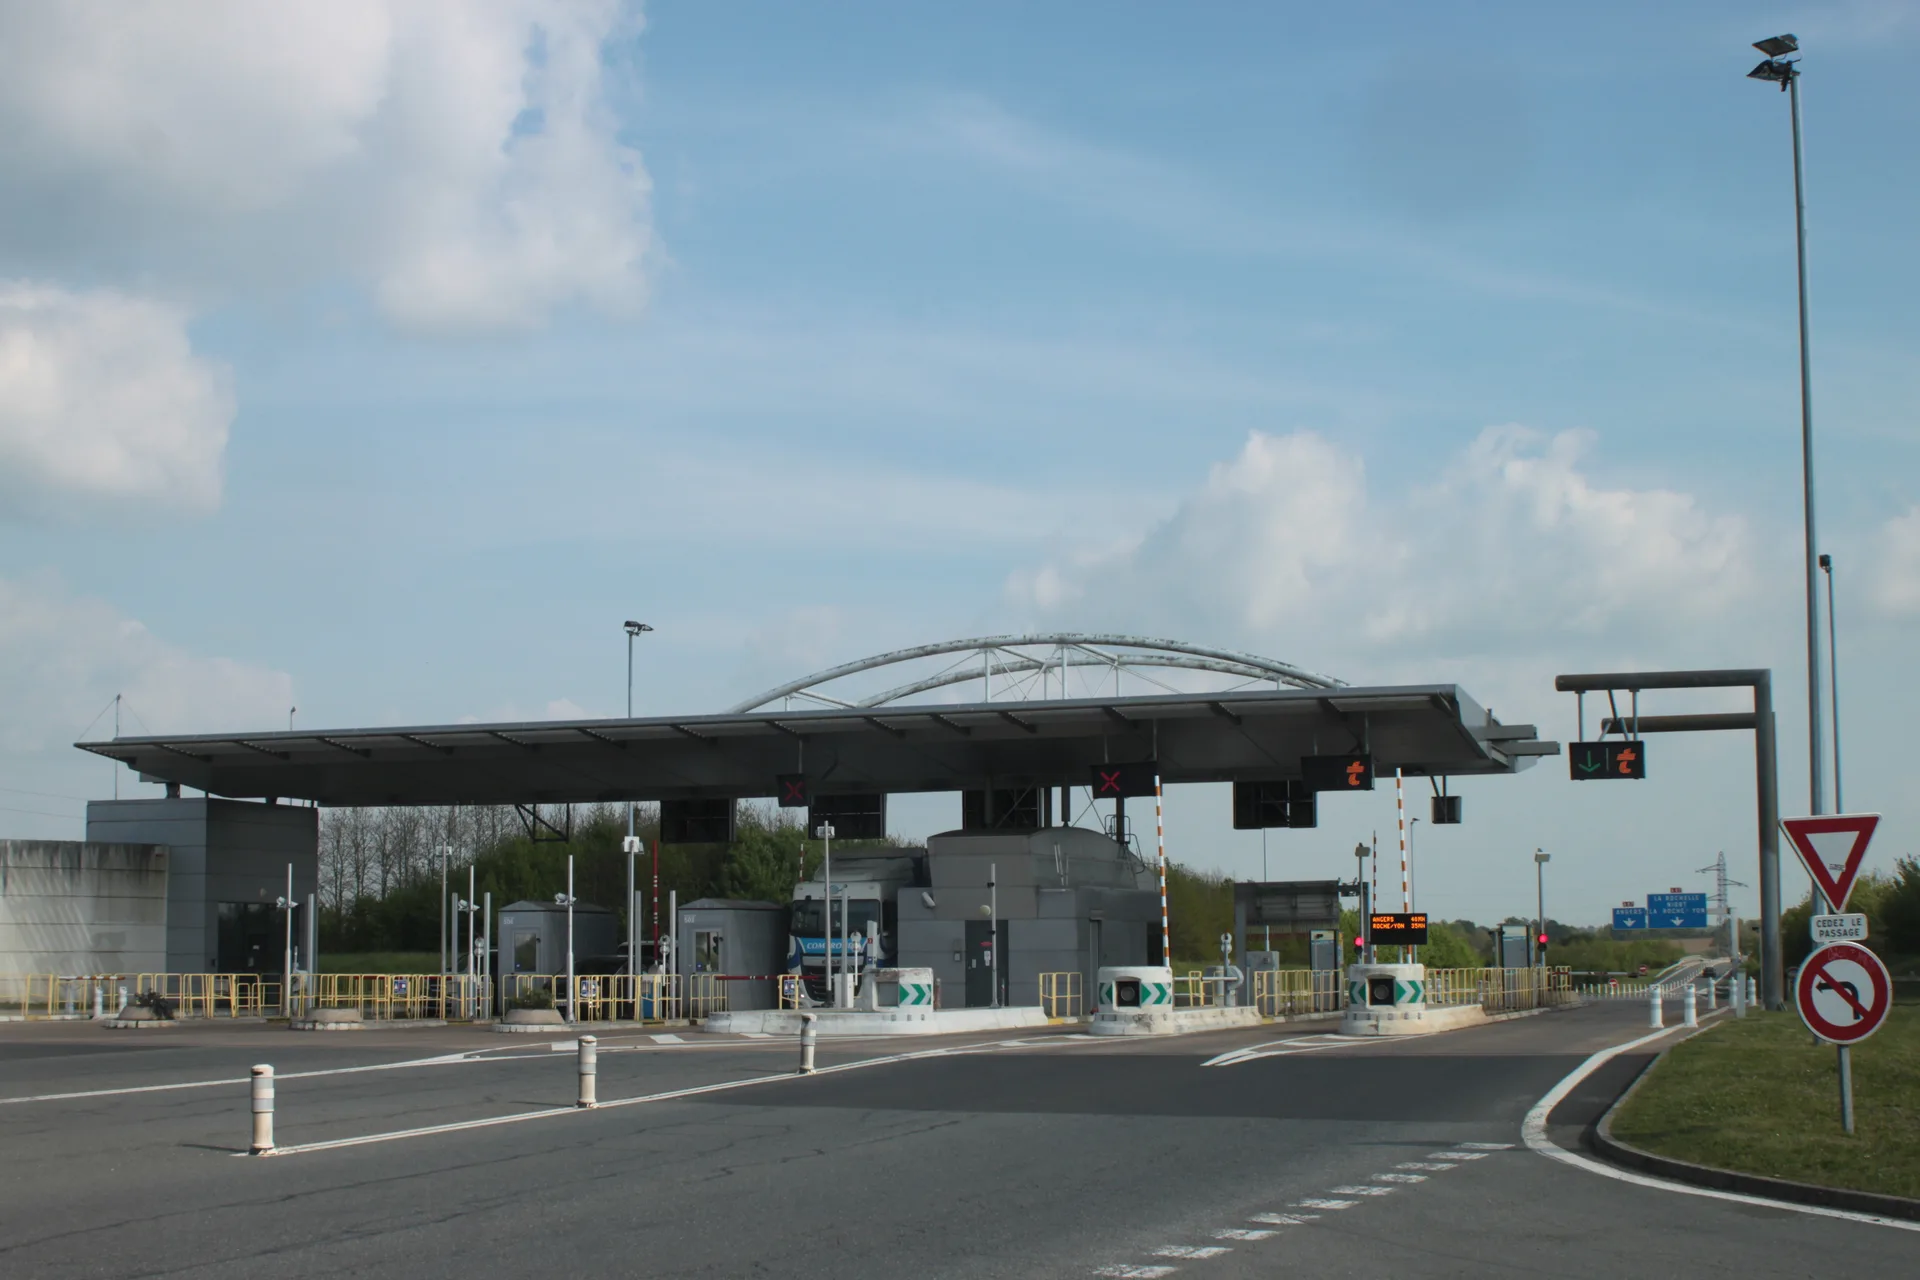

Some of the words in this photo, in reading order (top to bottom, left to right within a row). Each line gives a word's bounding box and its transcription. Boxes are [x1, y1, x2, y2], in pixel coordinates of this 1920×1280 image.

[1816, 918, 1844, 928] CEDEZ
[1851, 917, 1862, 926] LE
[1819, 928, 1860, 938] PASSAGE
